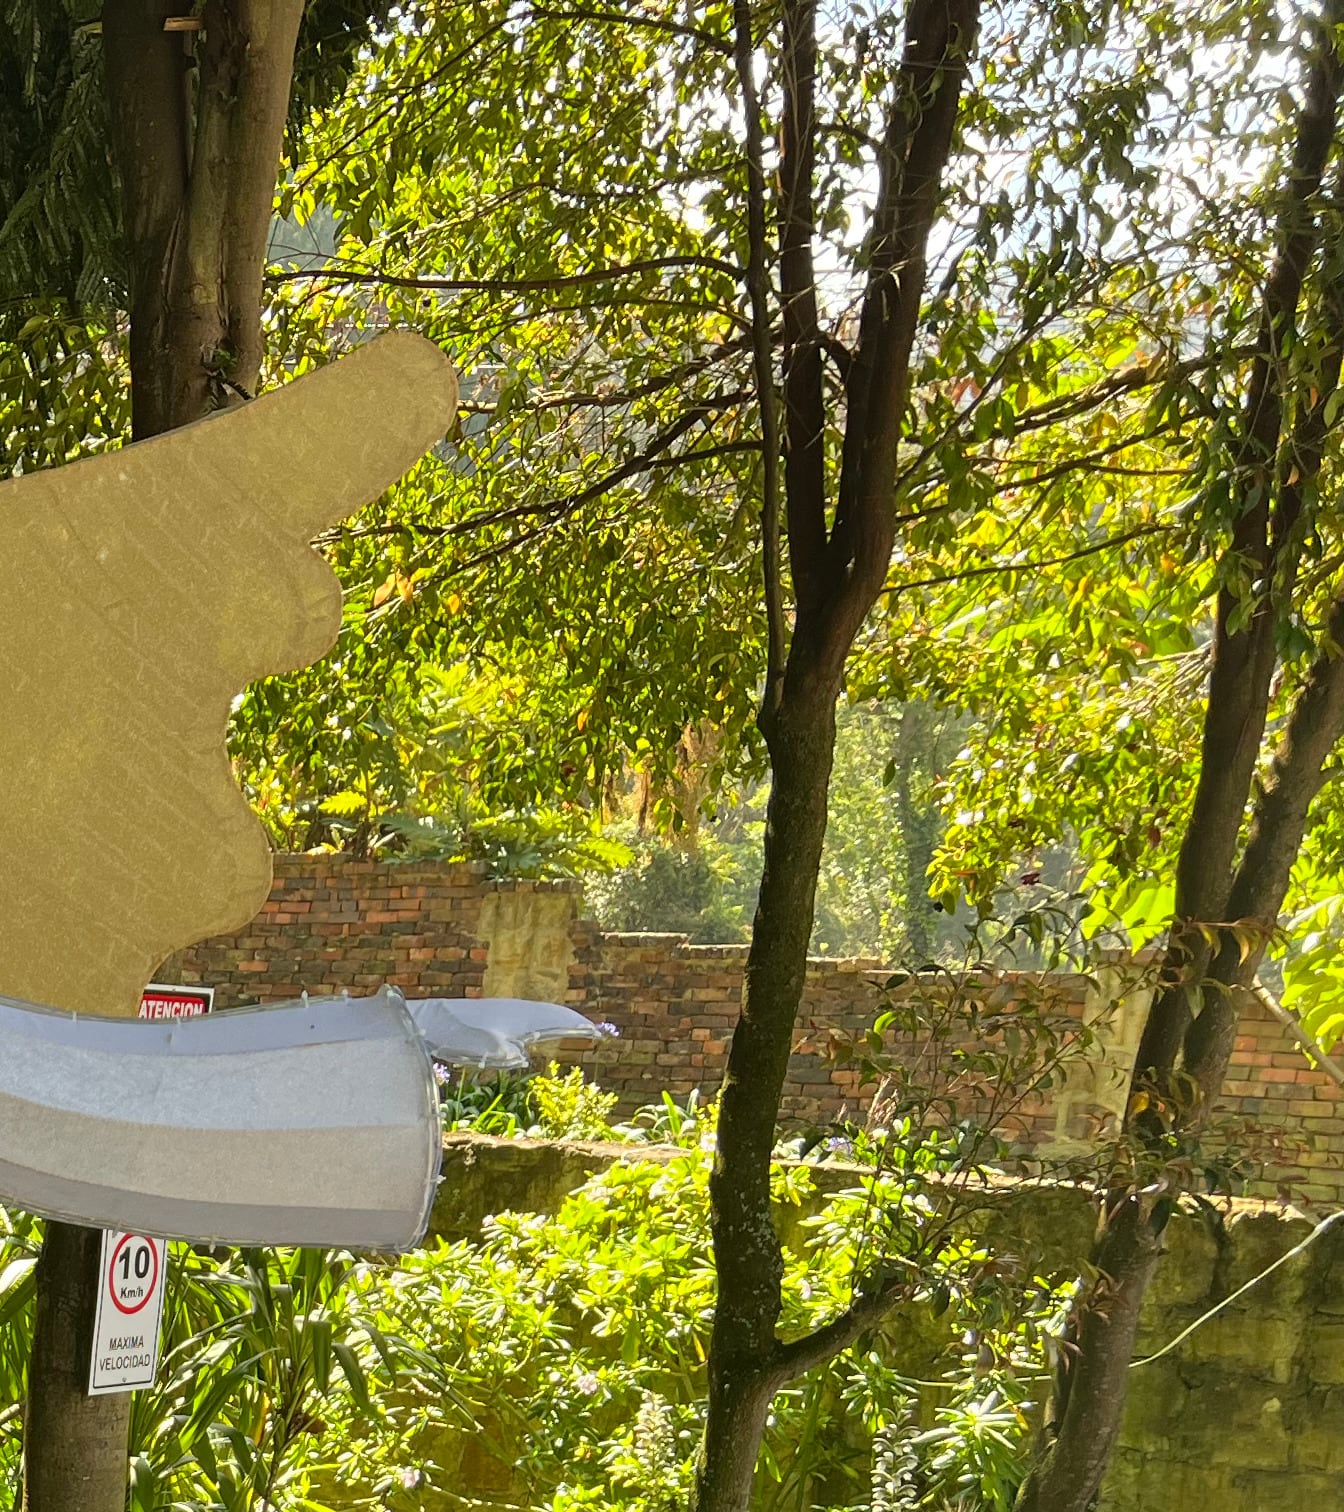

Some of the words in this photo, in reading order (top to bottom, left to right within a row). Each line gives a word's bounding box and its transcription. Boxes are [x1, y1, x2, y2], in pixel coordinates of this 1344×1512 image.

[138, 999, 204, 1019] ATENCION
[119, 1245, 150, 1279] 10
[120, 1286, 144, 1299] Km/h
[109, 1335, 144, 1351] MAXIMA
[99, 1353, 150, 1371] VELOCIDAD
